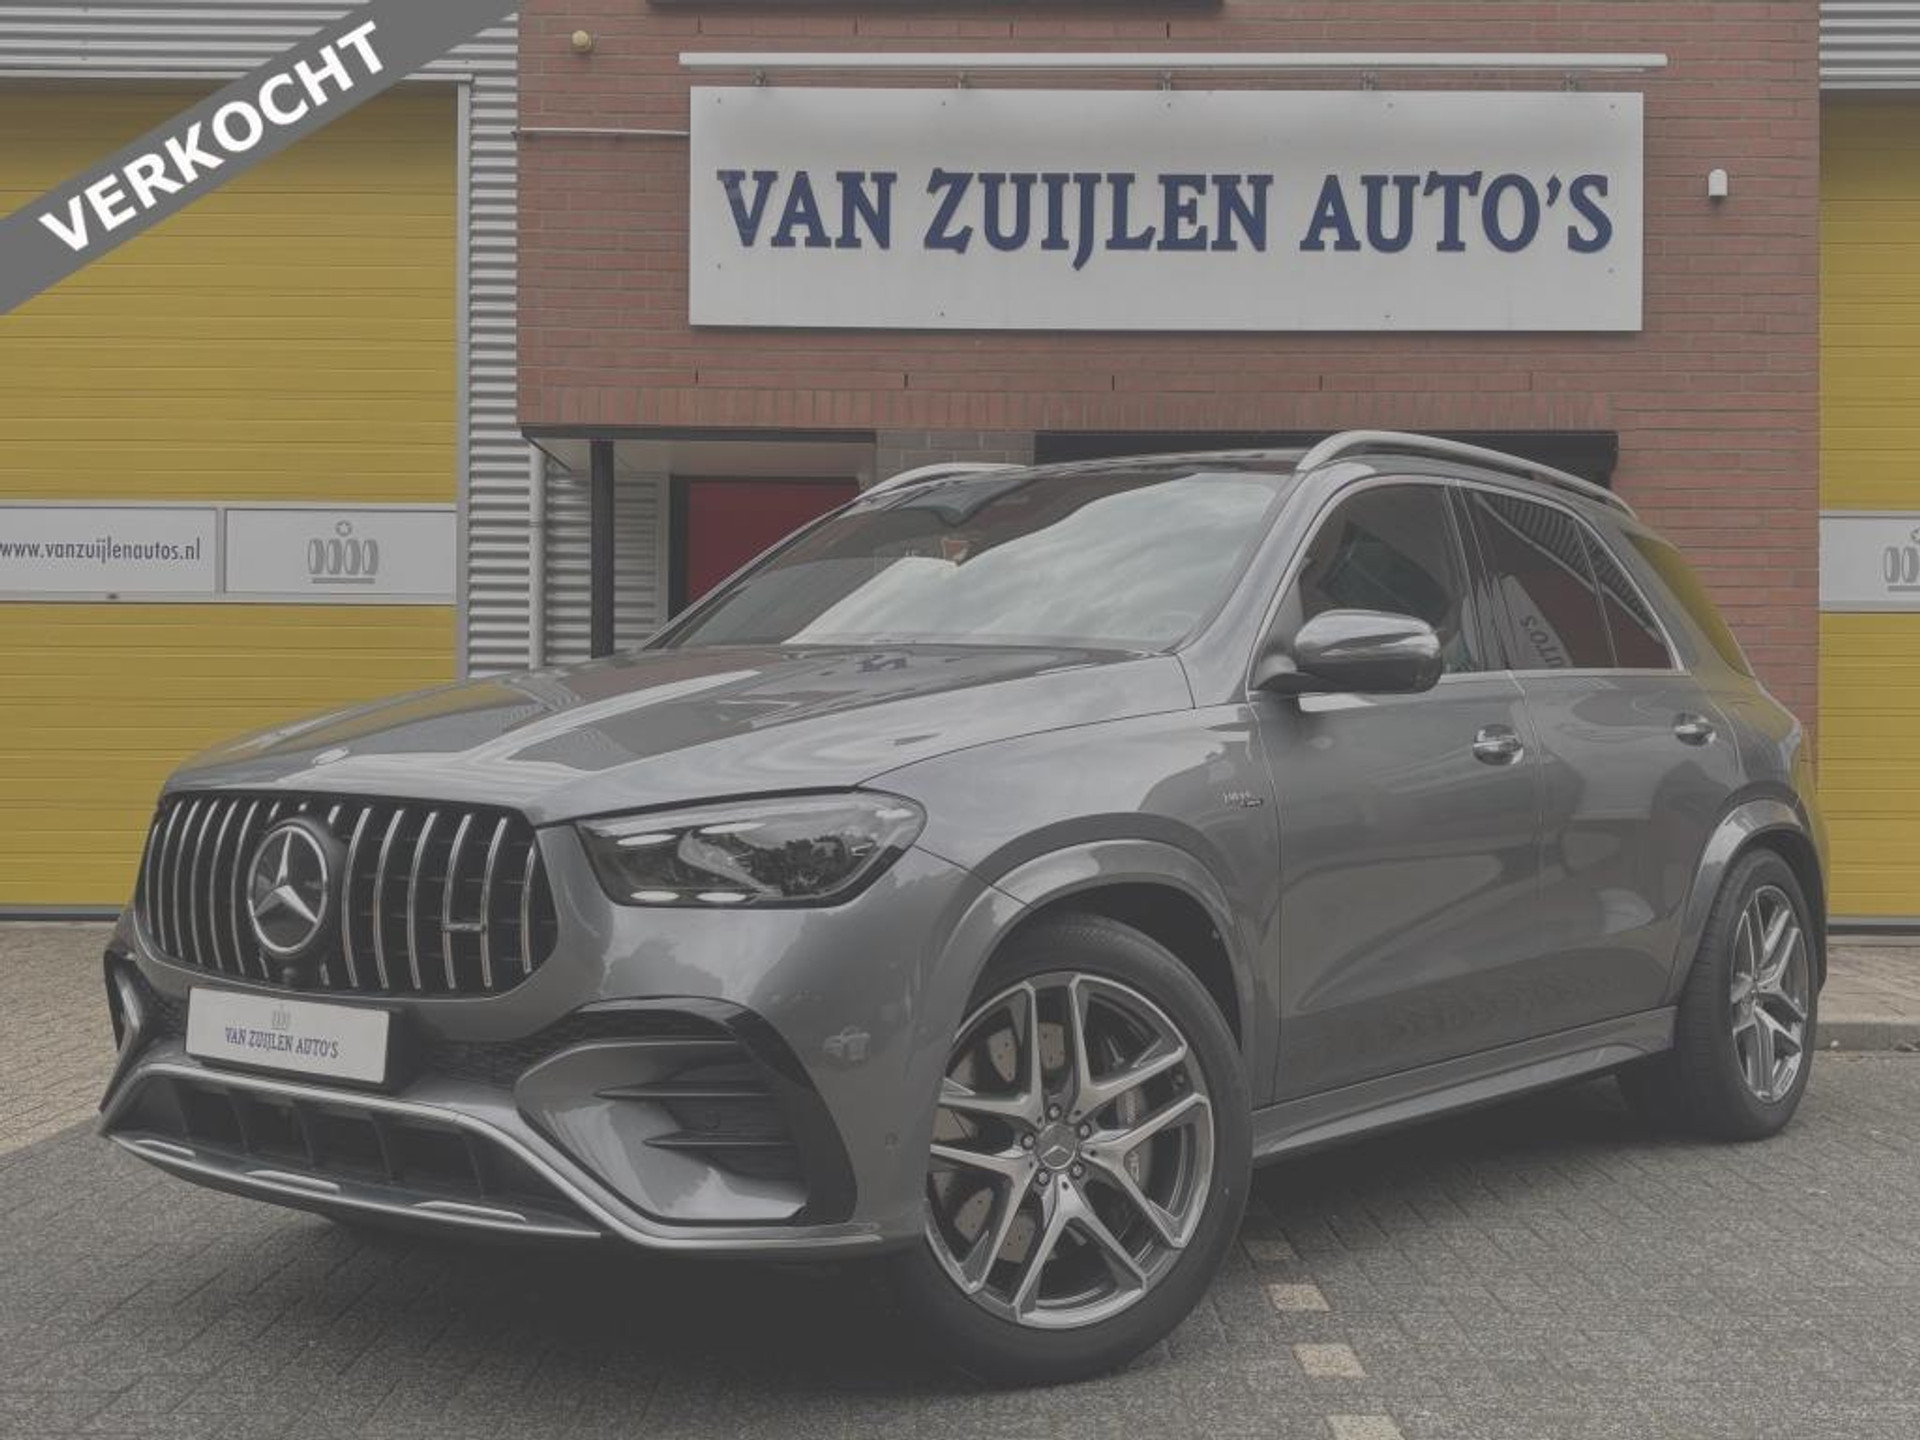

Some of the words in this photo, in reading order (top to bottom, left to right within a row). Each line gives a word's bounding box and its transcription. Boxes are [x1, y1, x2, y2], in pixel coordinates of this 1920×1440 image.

[716, 170, 898, 250] VAN
[923, 167, 1274, 272] ZUIJLEN
[1299, 170, 1613, 254] AUTO'S
[0, 535, 200, 564] www.vanzuijlenautos.nl
[225, 1027, 246, 1045] VAN
[248, 1030, 293, 1052] ZUIJLEN
[295, 1038, 338, 1059] AUTO'S
